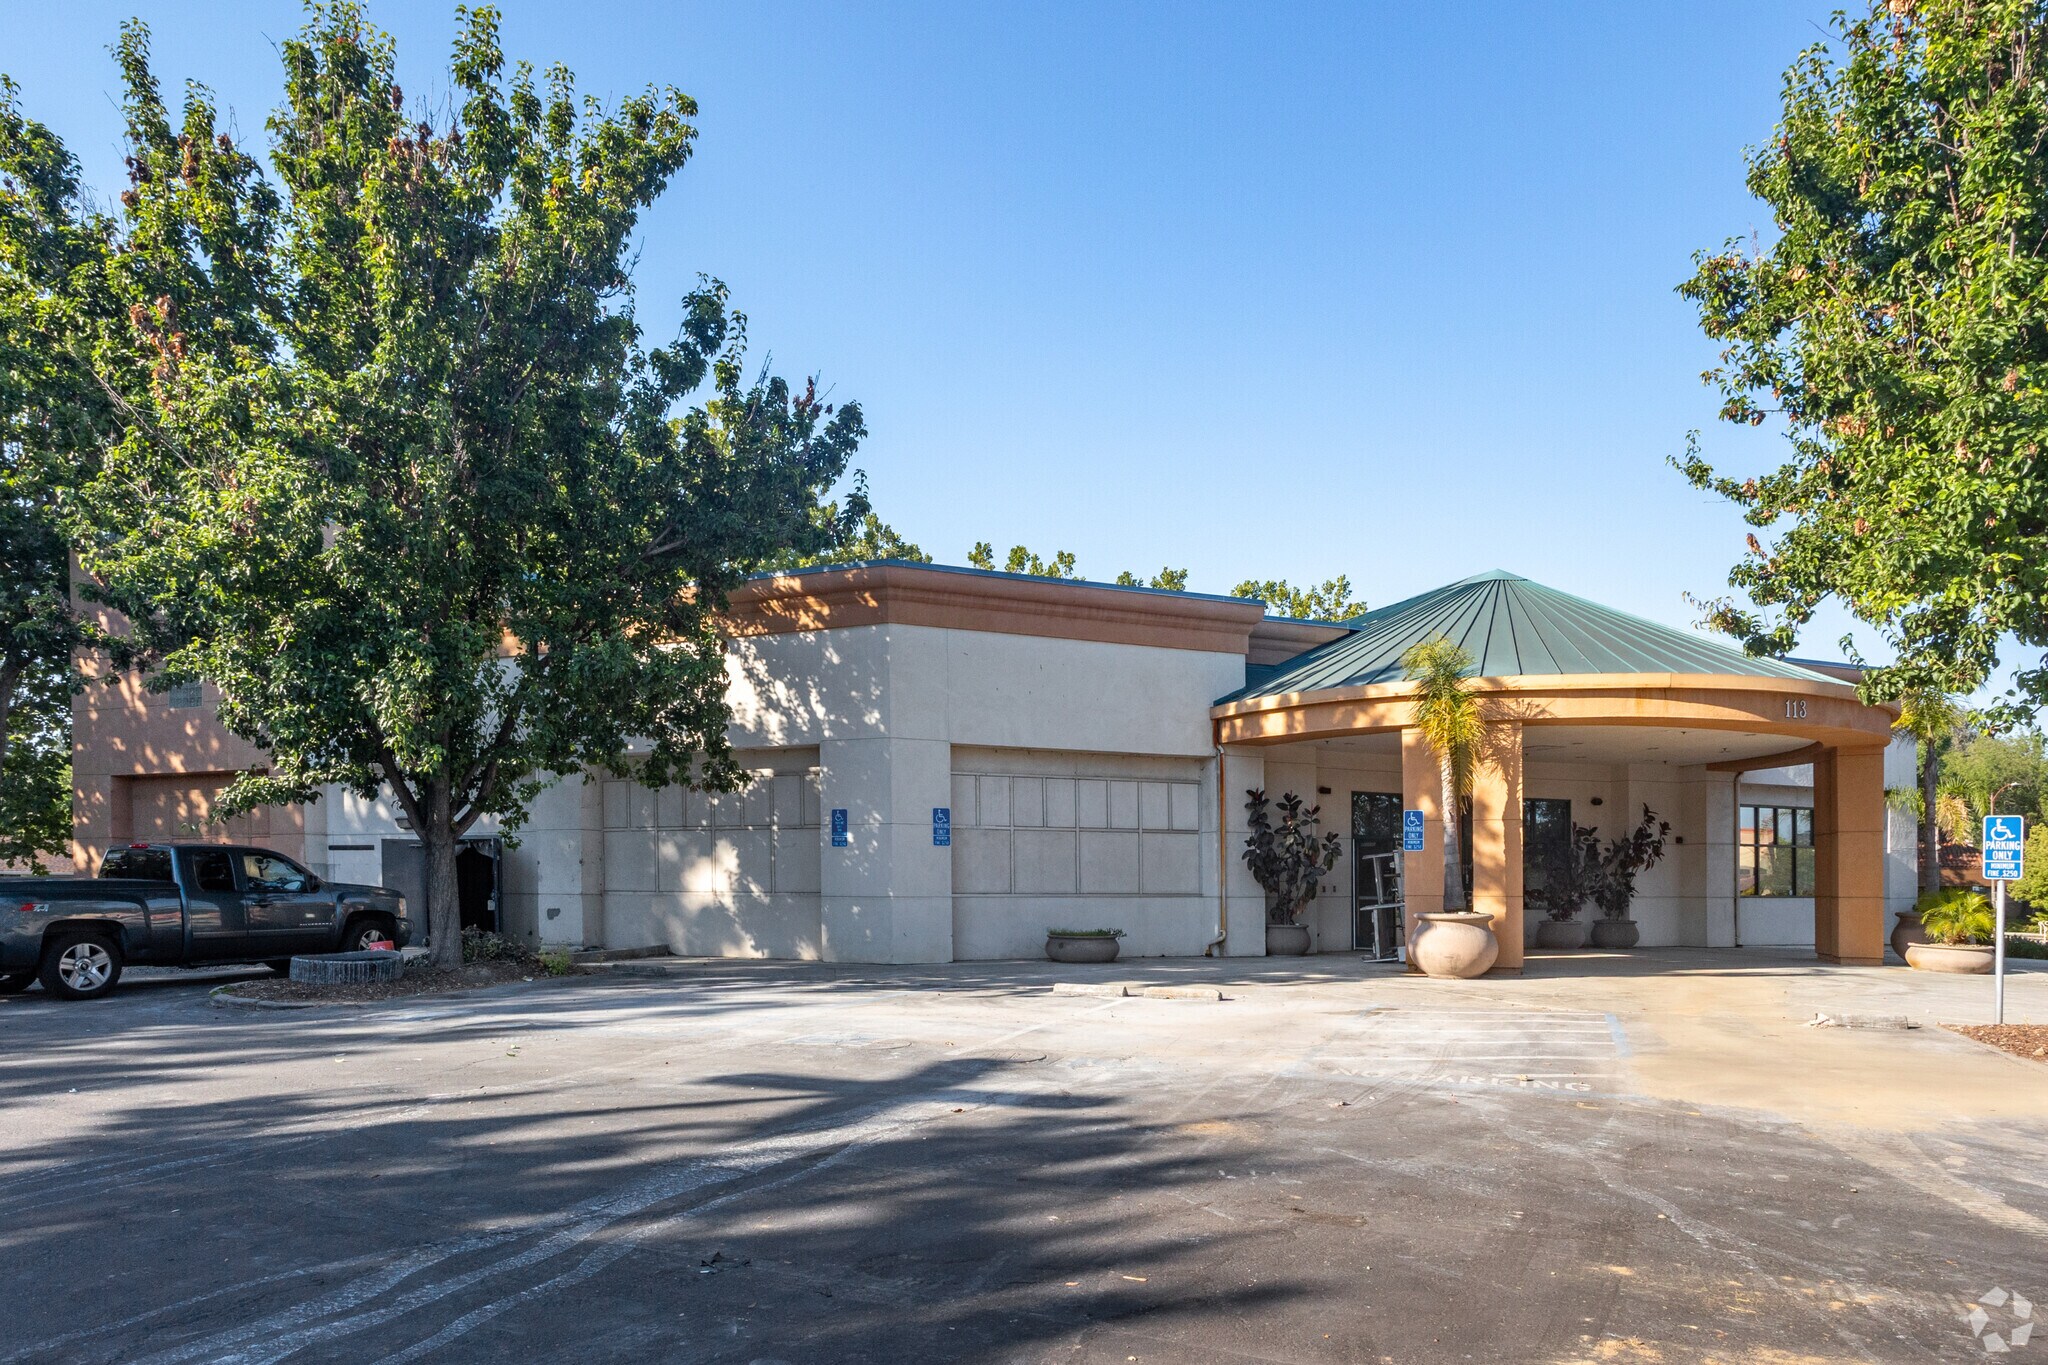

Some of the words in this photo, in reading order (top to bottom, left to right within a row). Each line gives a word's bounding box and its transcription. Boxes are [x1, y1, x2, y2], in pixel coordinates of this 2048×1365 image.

[1785, 699, 1807, 718] 113
[1986, 841, 2020, 850] PARKING
[1993, 851, 2013, 860] ONLY
